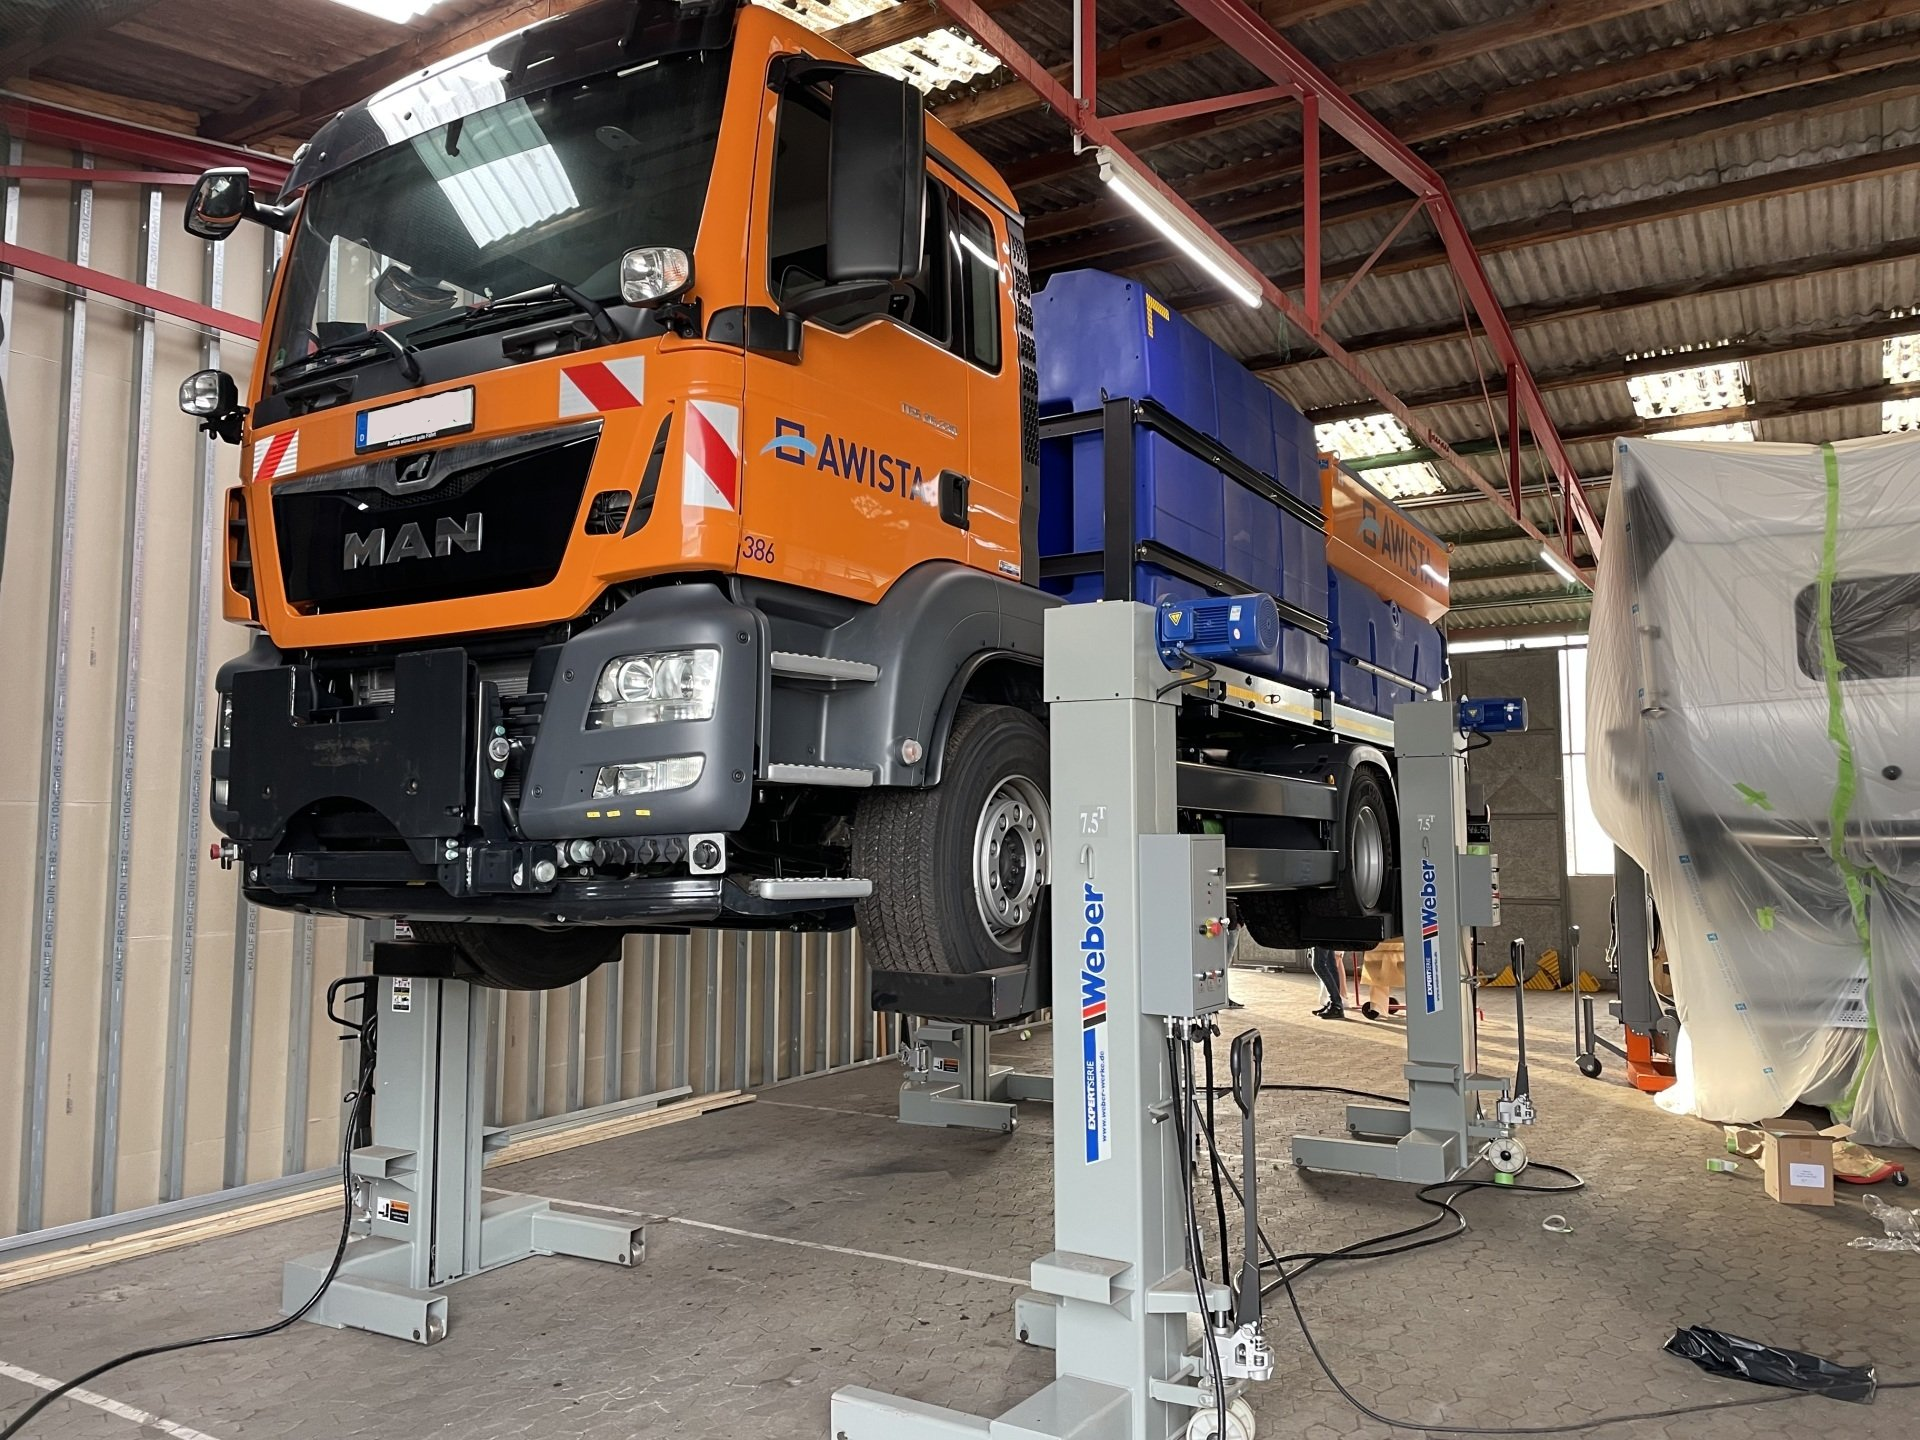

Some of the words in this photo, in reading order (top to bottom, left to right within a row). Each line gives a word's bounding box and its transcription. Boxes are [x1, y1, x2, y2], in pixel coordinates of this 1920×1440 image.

[817, 433, 927, 501] AWISTA
[343, 512, 483, 570] MAN
[743, 536, 775, 563] 386
[1381, 514, 1434, 588] AWISTA
[46, 885, 56, 904] DIN
[118, 882, 128, 901] DIN
[187, 880, 196, 898] DIN
[1420, 859, 1438, 928] Weber
[44, 908, 54, 948] PROFIL
[116, 904, 126, 943] PROFIL
[186, 901, 194, 938] PROFIL
[184, 940, 192, 975] KNAUF
[247, 937, 255, 971] KNAUF
[1080, 882, 1106, 1008] Weber
[42, 951, 52, 988] KNAUF
[115, 946, 124, 982] KNAUF
[1087, 1060, 1096, 1131] EXPERTSERIE
